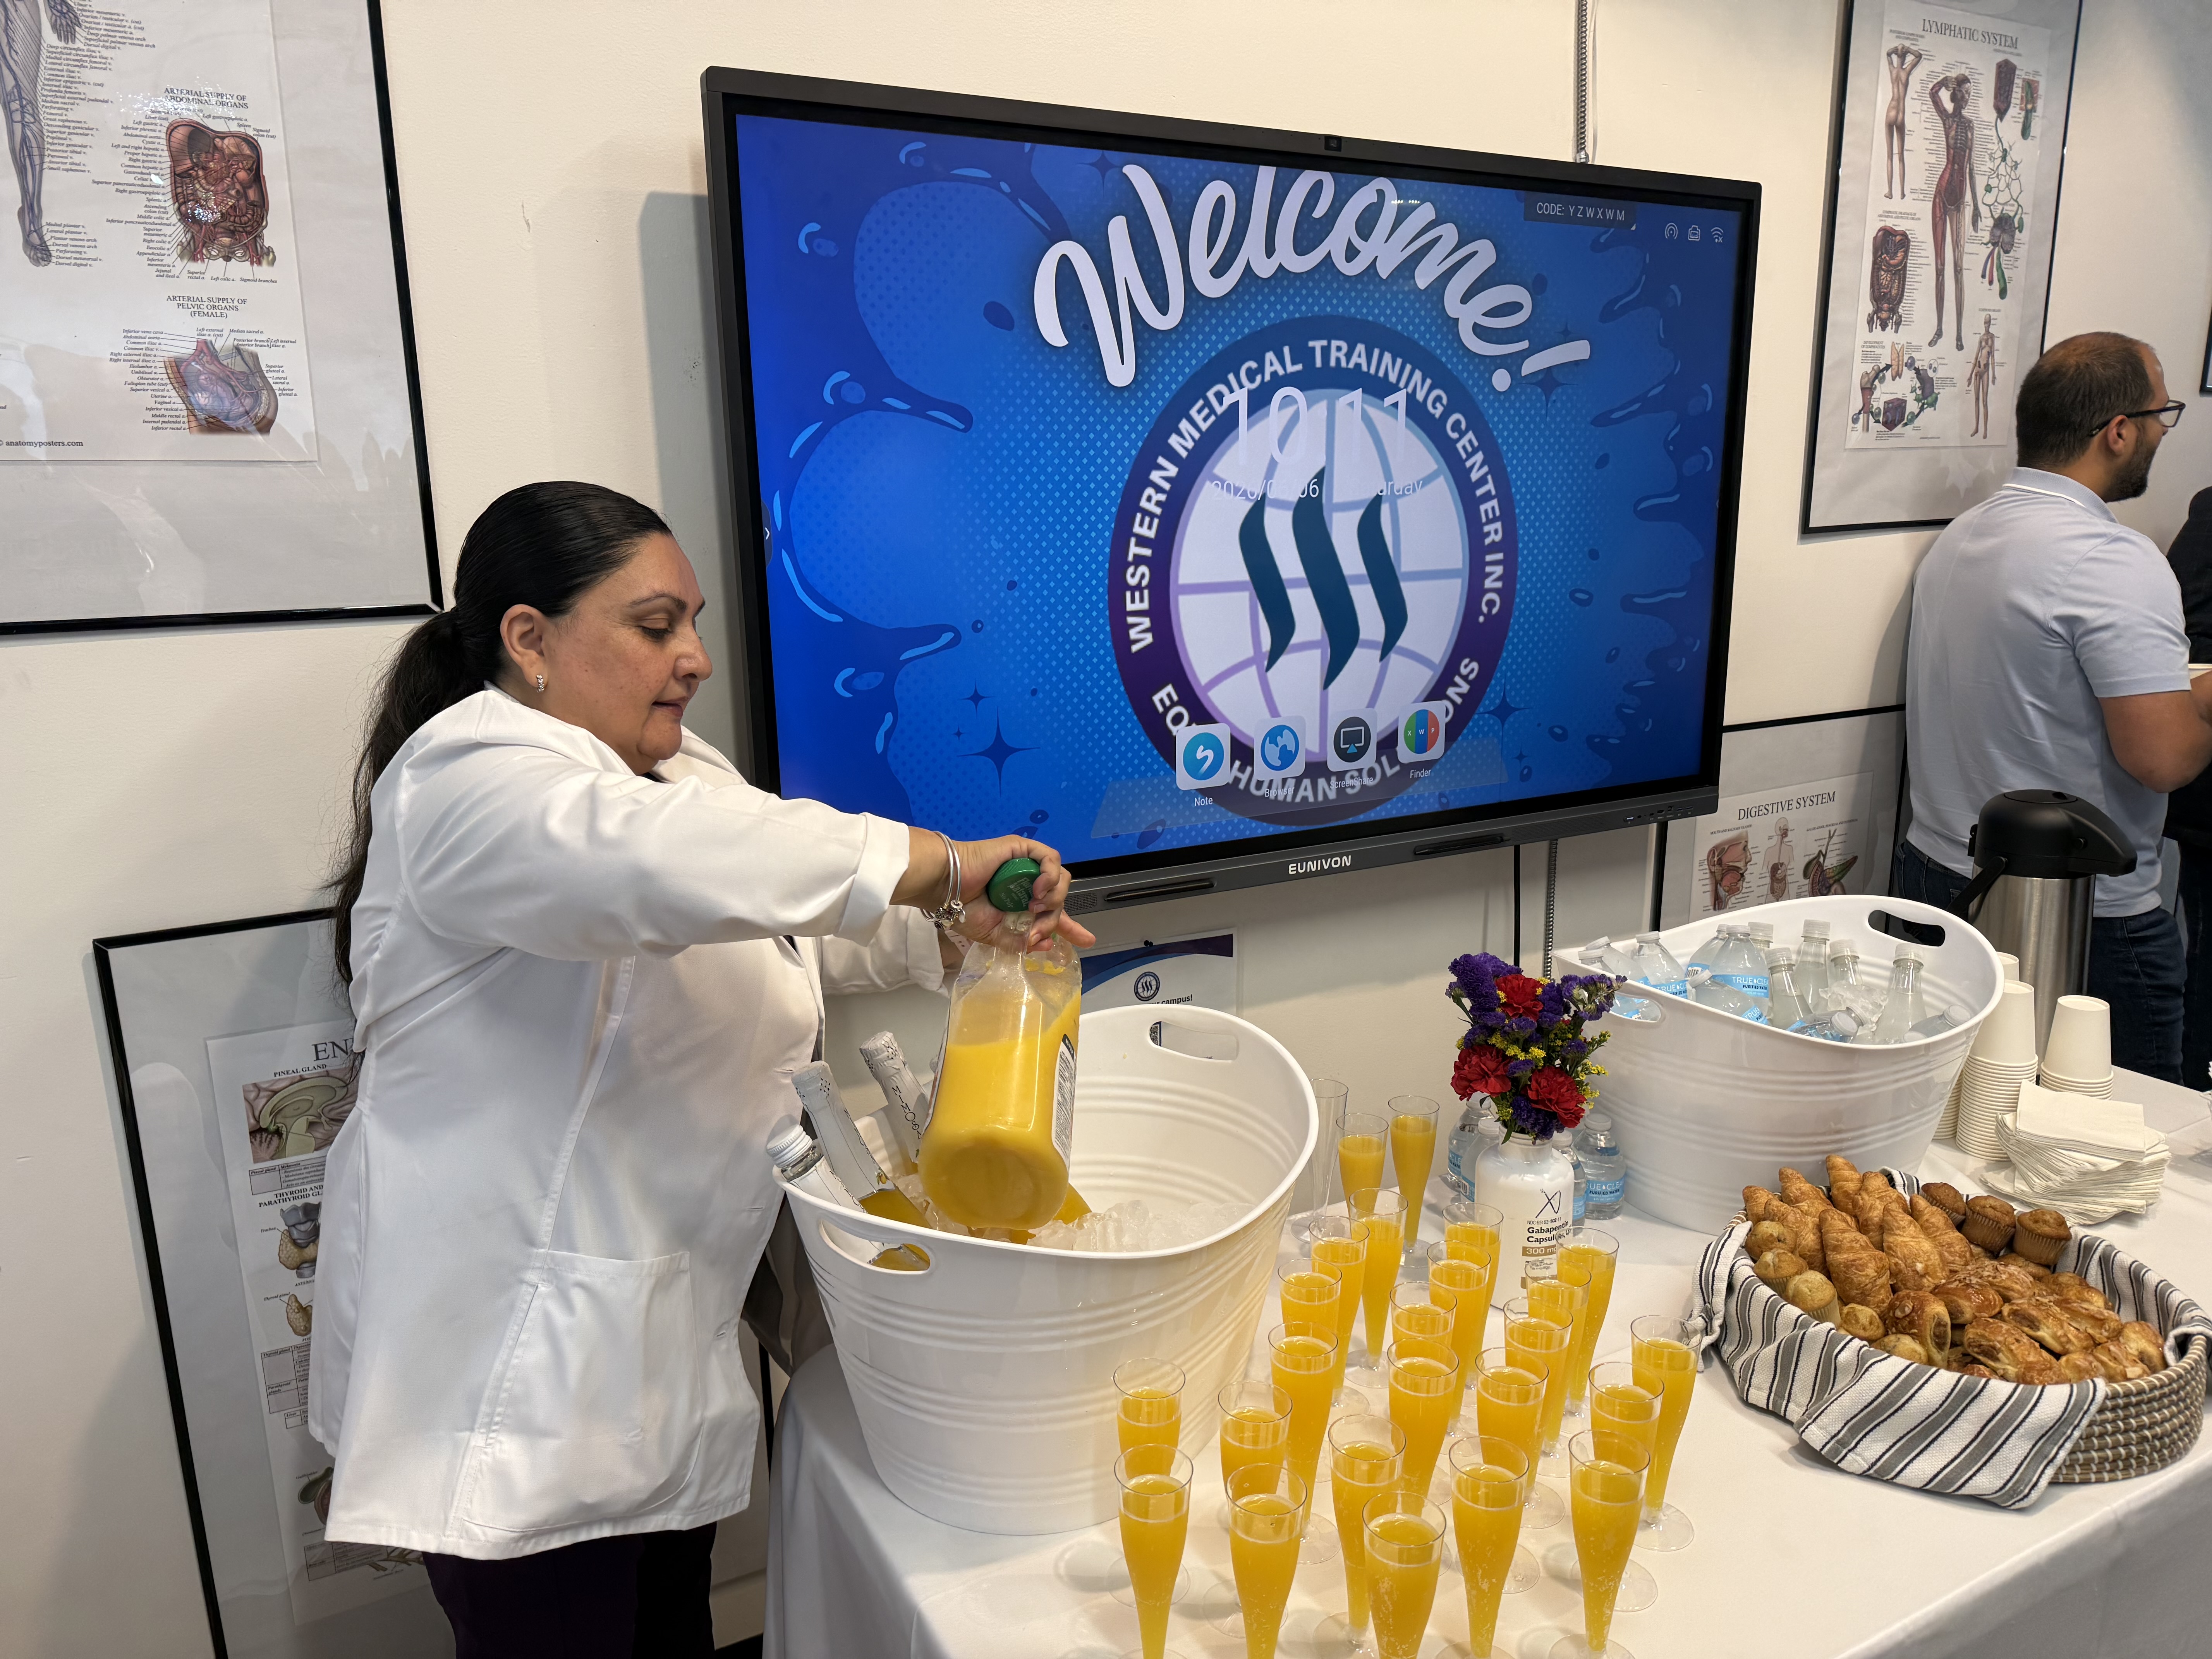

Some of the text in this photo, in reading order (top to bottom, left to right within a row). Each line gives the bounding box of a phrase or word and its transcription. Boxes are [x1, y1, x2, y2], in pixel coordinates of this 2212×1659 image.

[1922, 19, 2018, 49] LYMPHATIC SYSTEM
[164, 88, 204, 97] ARTERIAL
[205, 91, 234, 100] SUPPLY
[165, 95, 248, 109] ABDOMINAL ORGANS
[1537, 202, 1565, 215] CODE:
[1034, 164, 1590, 392] Welcome!
[1125, 339, 1504, 653] WESTERN MEDICAL TRAINING CENTER INC.
[1410, 769, 1431, 778] Finder
[1229, 759, 1338, 803] HUMAN
[1329, 776, 1374, 789] ScreenShare
[1264, 785, 1295, 797] Browser
[1194, 796, 1213, 807] Note
[1738, 791, 1836, 821] DIGESTIVE SYSTEM
[1288, 855, 1352, 874] EUNIVON
[1161, 994, 1192, 1005] campus!
[274, 1064, 326, 1077] PINEAL GLAND
[892, 1085, 921, 1140] MIMOSA
[274, 1187, 307, 1198] THYROID
[259, 1193, 310, 1207] PARATHYROID
[1527, 1221, 1568, 1234] Gabapentin
